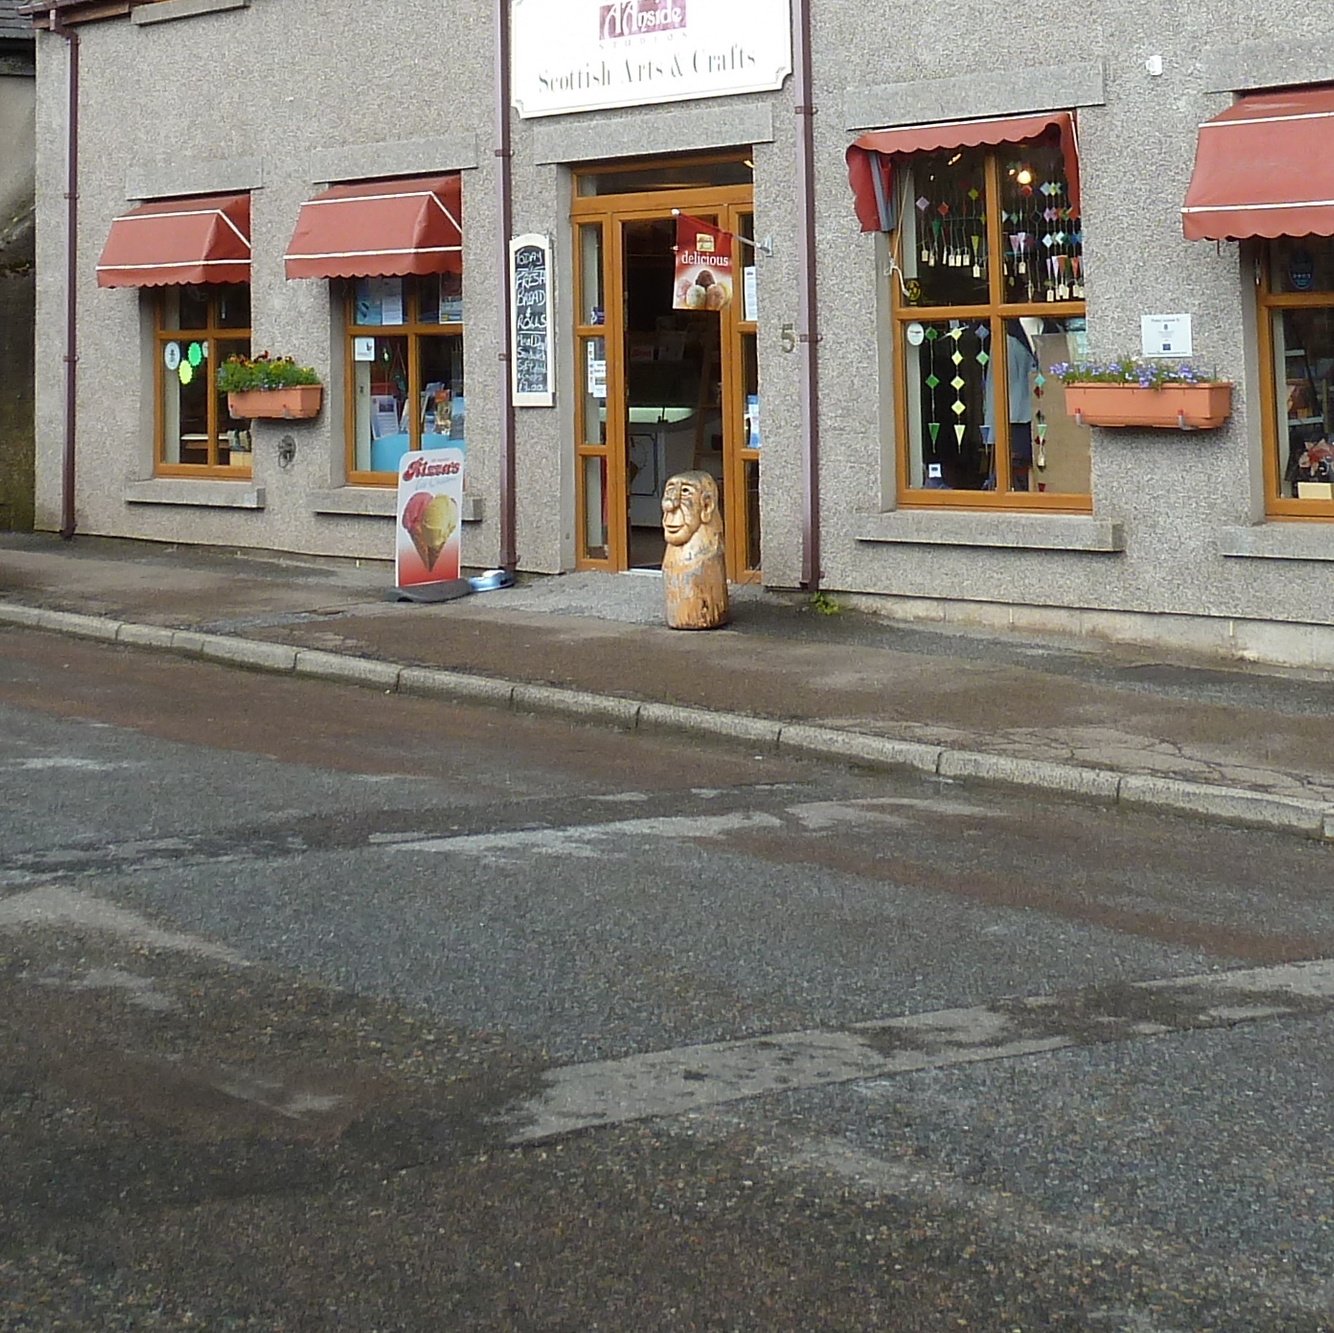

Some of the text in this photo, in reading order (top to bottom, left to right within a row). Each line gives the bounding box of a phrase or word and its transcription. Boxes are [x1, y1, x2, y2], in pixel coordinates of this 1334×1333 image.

[538, 43, 756, 93] Scottish Arts & Crafts
[515, 248, 543, 266] TODAY
[681, 250, 729, 266] delicious
[515, 269, 546, 289] FRESH
[780, 322, 795, 354] 5
